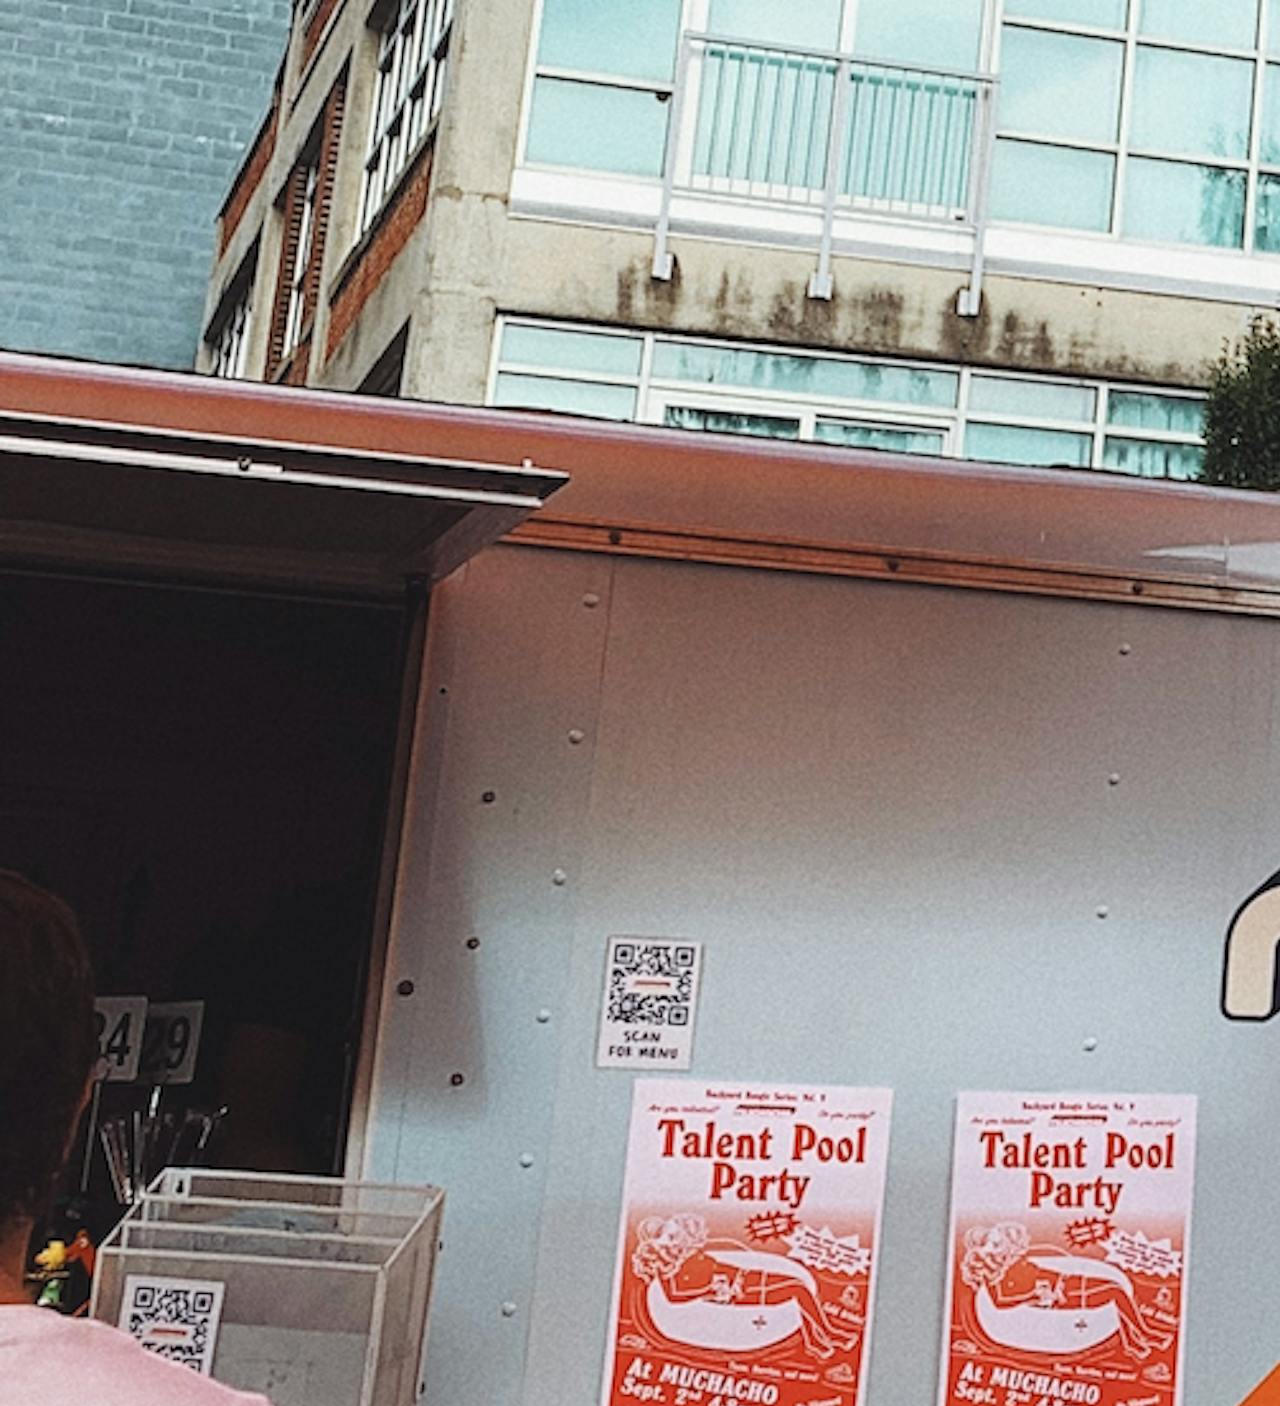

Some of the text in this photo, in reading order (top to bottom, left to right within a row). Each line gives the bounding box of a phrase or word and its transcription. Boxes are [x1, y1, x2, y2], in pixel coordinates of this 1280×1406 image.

[623, 1030, 661, 1042] SCAN
[639, 1047, 679, 1060] MENU
[657, 1119, 867, 1163] Talent Pool
[979, 1131, 1175, 1169] Talent Pool
[709, 1162, 811, 1208] Party
[1030, 1171, 1123, 1214] Party
[619, 1377, 667, 1403] Sept.
[674, 1387, 702, 1406] 2nd
[626, 1357, 652, 1379] At
[658, 1363, 779, 1406] MUCHACHO
[954, 1381, 997, 1405] Sept.
[959, 1361, 982, 1383] At
[989, 1367, 1101, 1405] MUCHACHO
